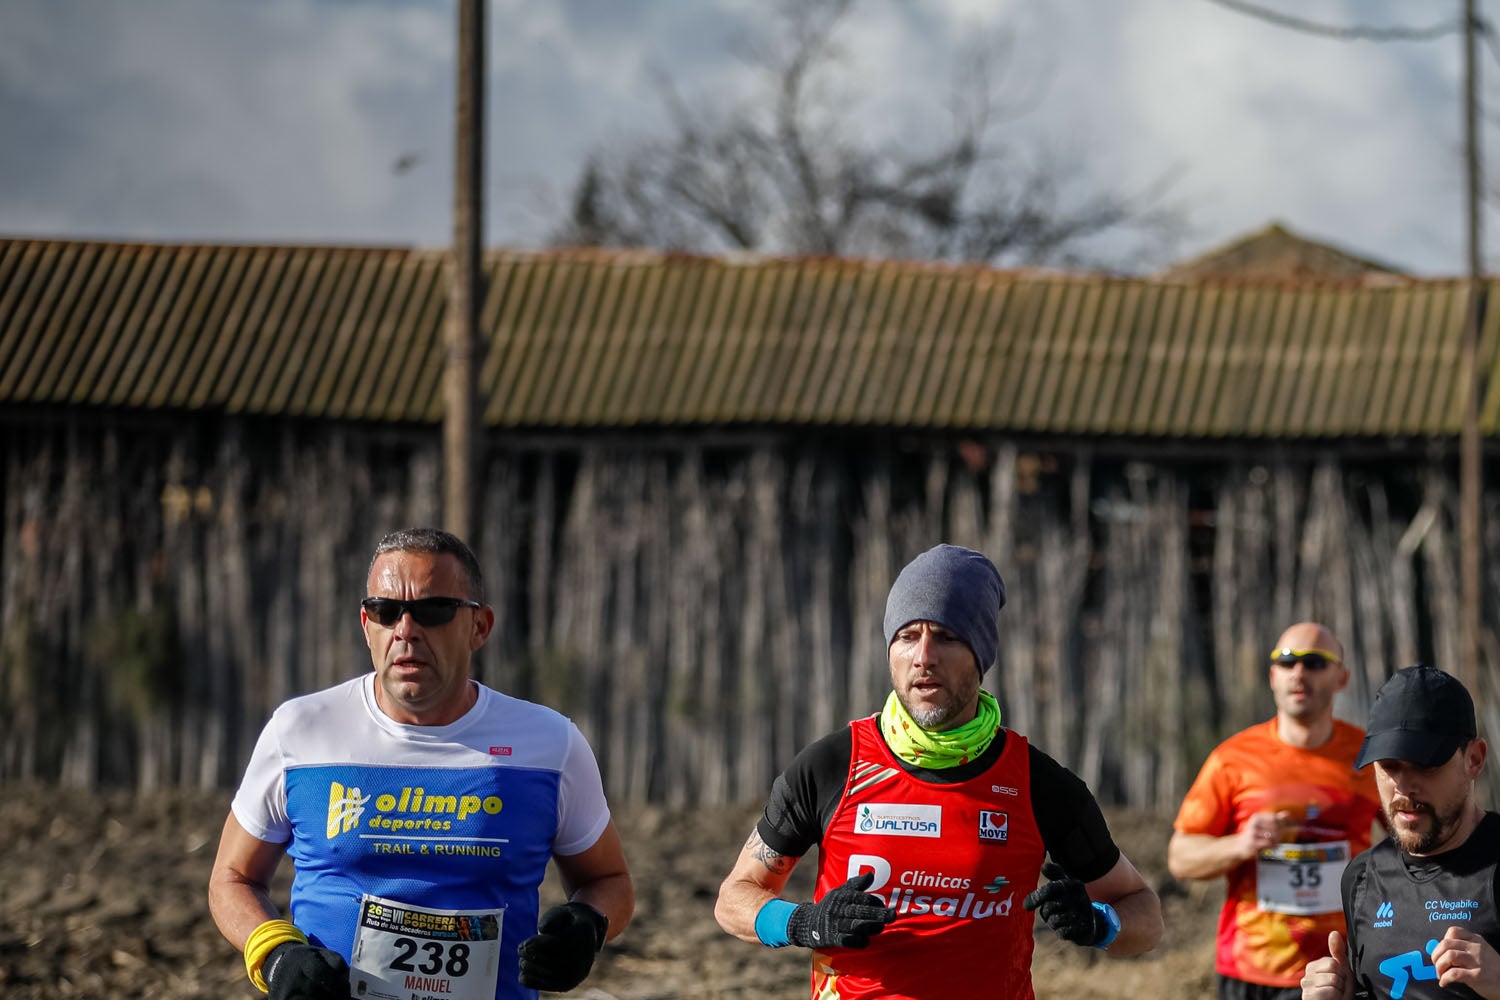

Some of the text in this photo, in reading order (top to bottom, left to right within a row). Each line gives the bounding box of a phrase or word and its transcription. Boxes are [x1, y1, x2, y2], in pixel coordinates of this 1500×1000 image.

[375, 787, 503, 820] olimpo
[369, 815, 451, 831] deportes
[981, 812, 987, 827] I
[979, 828, 1007, 839] MOVE
[373, 843, 501, 857] TRAIL & RUNNING
[900, 870, 971, 890] Clínicas
[1289, 864, 1321, 888] 35
[847, 854, 1015, 919] Plisalud
[1425, 900, 1479, 910] CC Vegabike
[368, 904, 382, 915] 26
[393, 909, 404, 924] VII
[404, 911, 456, 924] CARRERA
[1429, 911, 1472, 921] (Granada)
[366, 918, 379, 927] Ruta
[400, 925, 431, 936] Secaderos
[404, 919, 456, 931] POPULAR
[389, 938, 471, 977] 238
[404, 975, 452, 993] MANUEL
